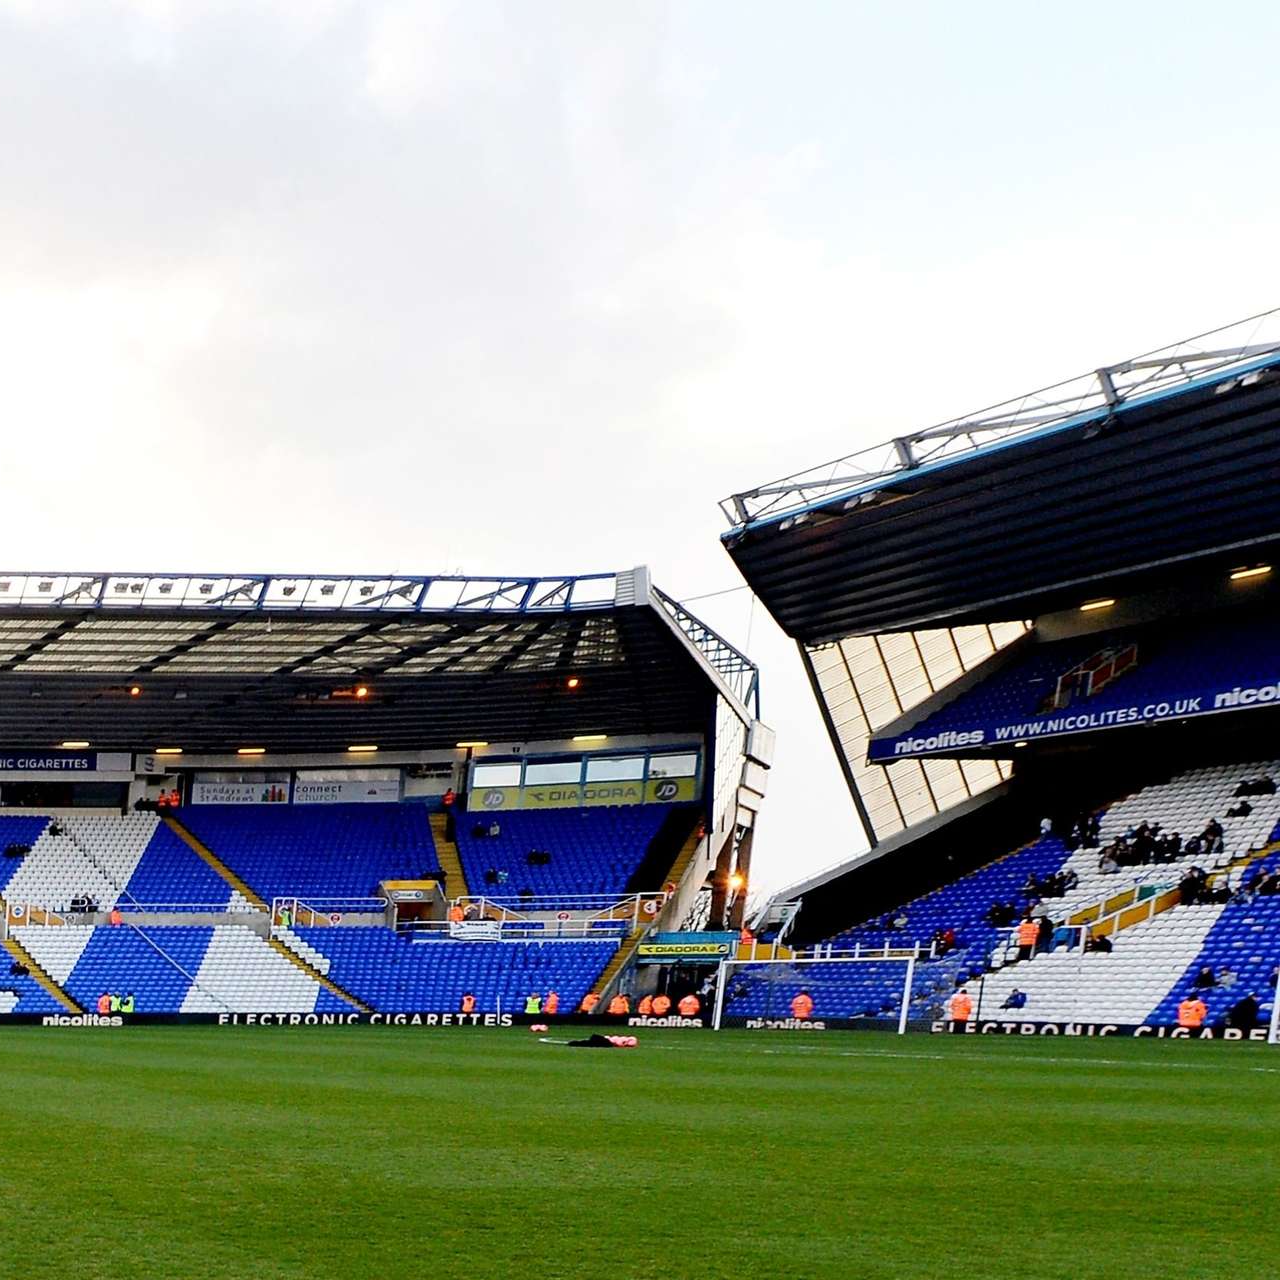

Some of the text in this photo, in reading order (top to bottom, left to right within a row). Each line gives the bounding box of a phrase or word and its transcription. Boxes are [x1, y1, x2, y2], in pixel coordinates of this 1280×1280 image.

[895, 729, 985, 754] nicolites
[995, 697, 1202, 740] WWW.NICOLITES.CO.UK
[17, 758, 88, 769] CIGARETTES
[296, 784, 342, 793] connect
[548, 786, 637, 802] DIADORA
[42, 1013, 123, 1027] nicolites
[218, 1012, 513, 1026] ELECTRONIC CIGARETTES
[628, 1015, 703, 1028] nicolites
